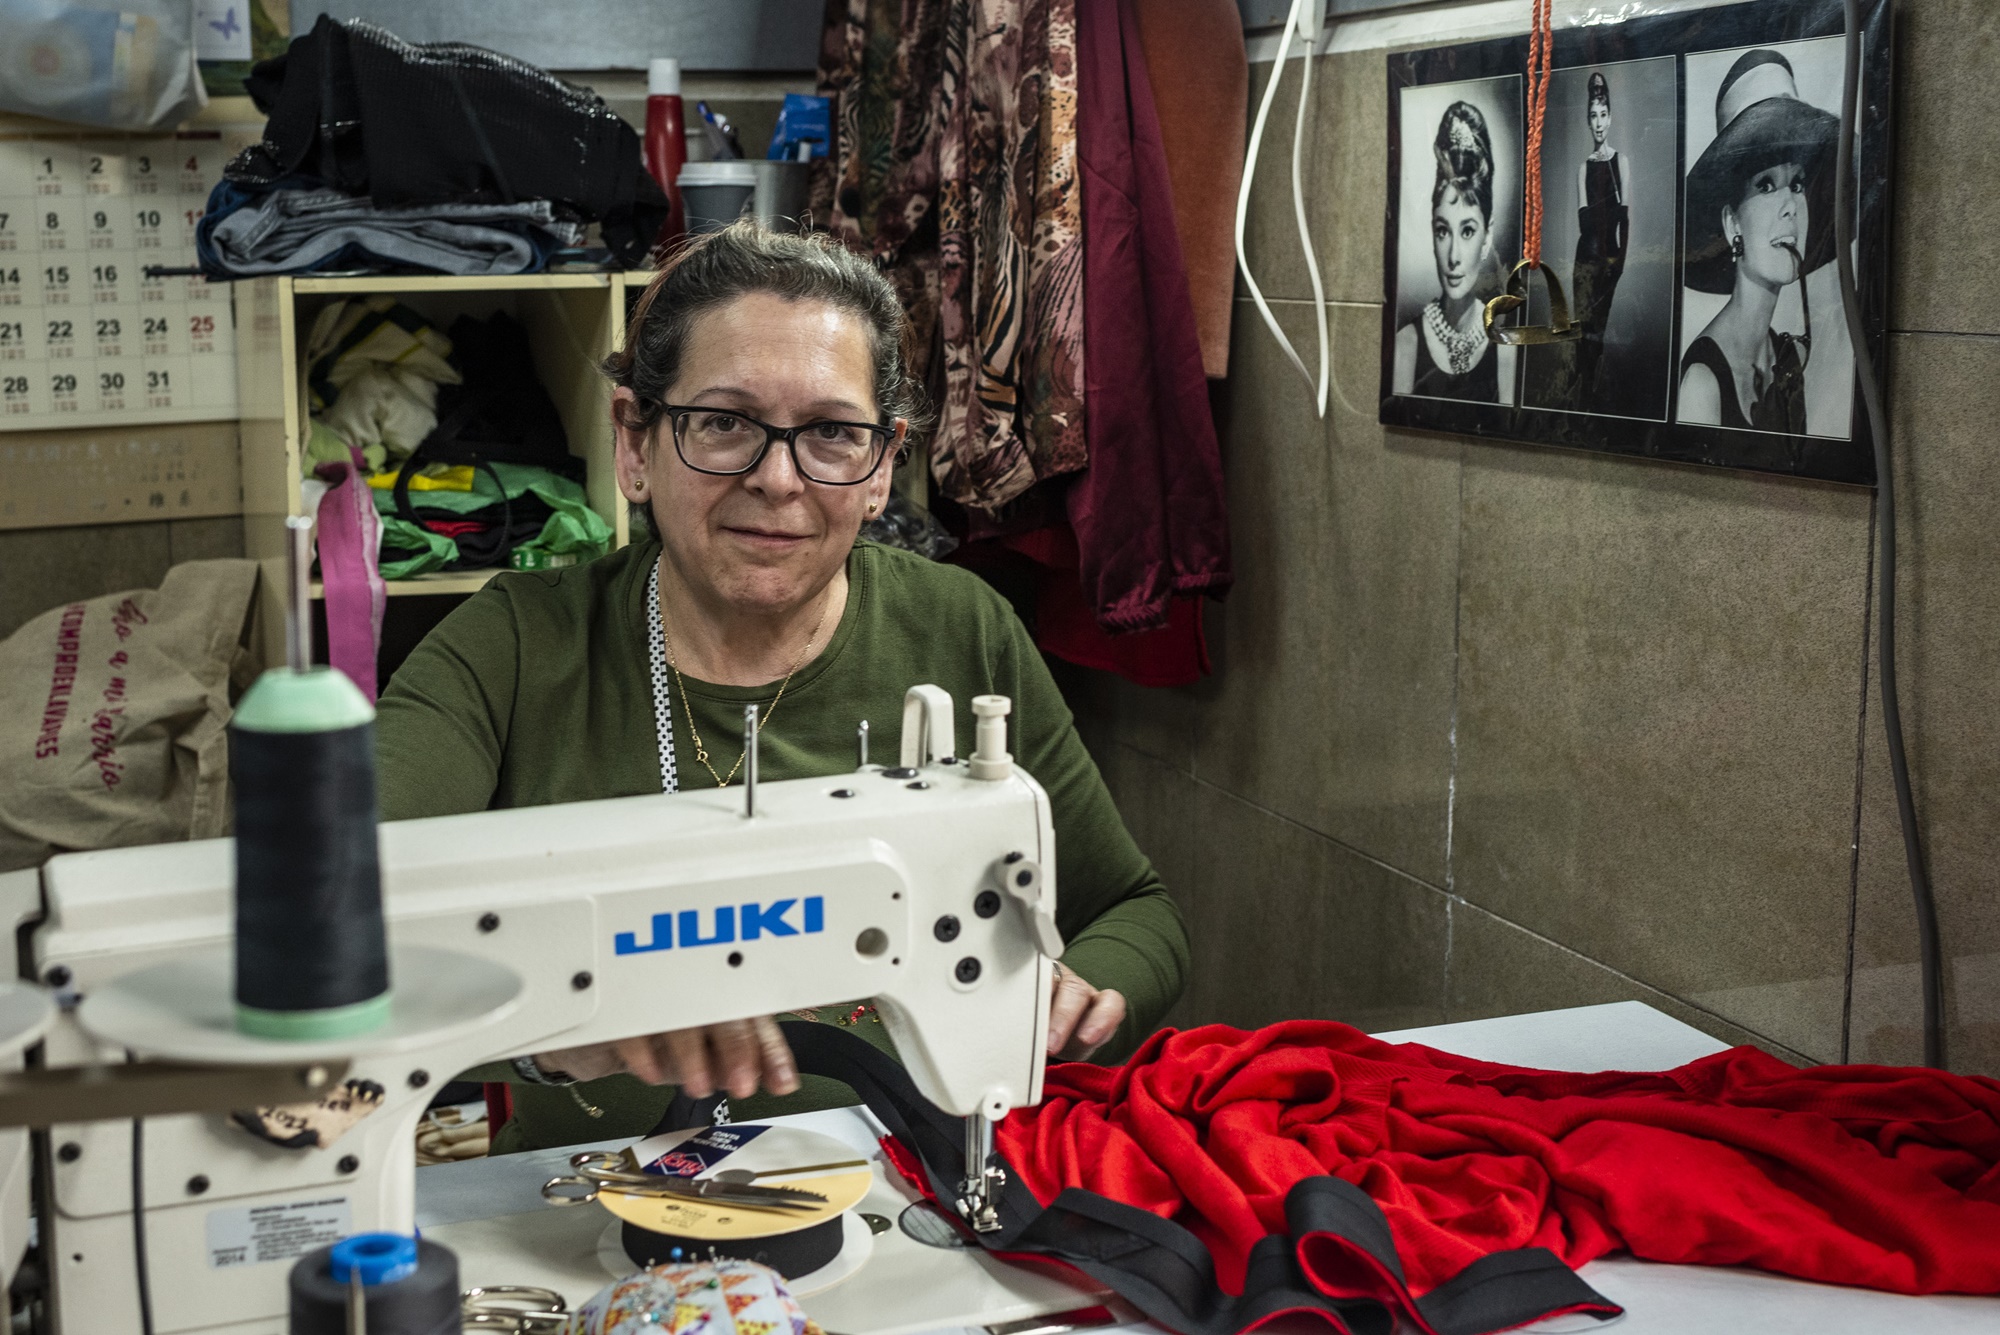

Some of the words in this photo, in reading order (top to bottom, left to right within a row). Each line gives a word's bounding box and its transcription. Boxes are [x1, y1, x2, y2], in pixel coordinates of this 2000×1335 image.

[43, 157, 53, 174] 1
[91, 157, 103, 174] 2
[139, 156, 151, 173] 3
[185, 156, 198, 172] 4
[0, 213, 9, 230] 7
[46, 212, 59, 229] 8
[94, 211, 107, 228] 9
[137, 210, 160, 227] 10
[45, 266, 70, 283] 15
[94, 265, 118, 282] 16
[0, 322, 22, 339] 21
[49, 321, 73, 338] 22
[97, 319, 121, 336] 23
[144, 318, 168, 334] 24
[190, 316, 215, 334] 25
[4, 376, 28, 393] 28
[52, 375, 76, 392] 29
[101, 373, 125, 390] 30
[147, 371, 169, 387] 31
[614, 896, 824, 956] JUKI
[712, 1130, 740, 1142] CINTA
